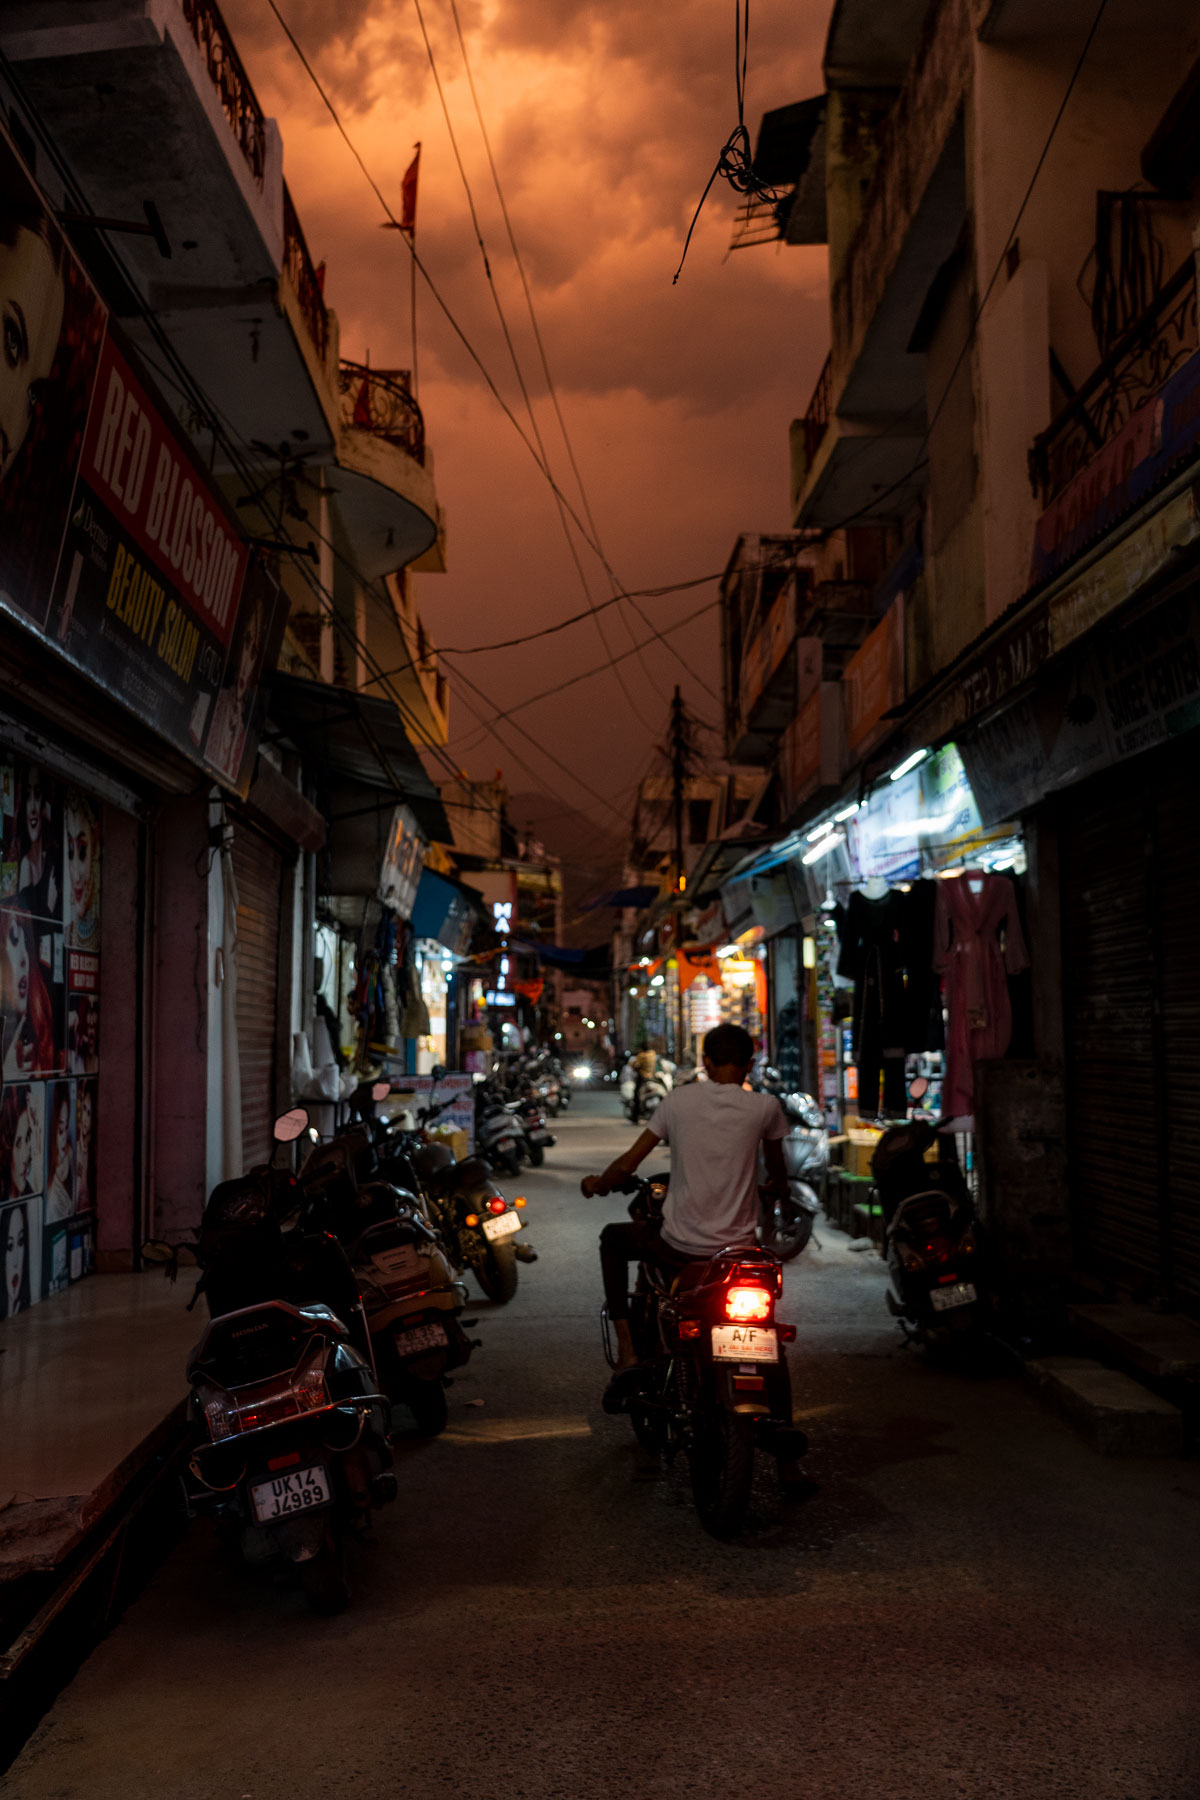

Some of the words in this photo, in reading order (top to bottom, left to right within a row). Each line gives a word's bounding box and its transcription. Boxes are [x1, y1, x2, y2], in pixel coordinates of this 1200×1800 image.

[93, 366, 152, 515] RED
[145, 442, 240, 629] BLOSSOM
[106, 541, 166, 648] BEAUTY
[157, 599, 201, 684] SALON
[231, 1322, 270, 1339] HONDA
[732, 1327, 757, 1343] A/F
[271, 1469, 315, 1497] UK14
[271, 1485, 324, 1517] J4989
